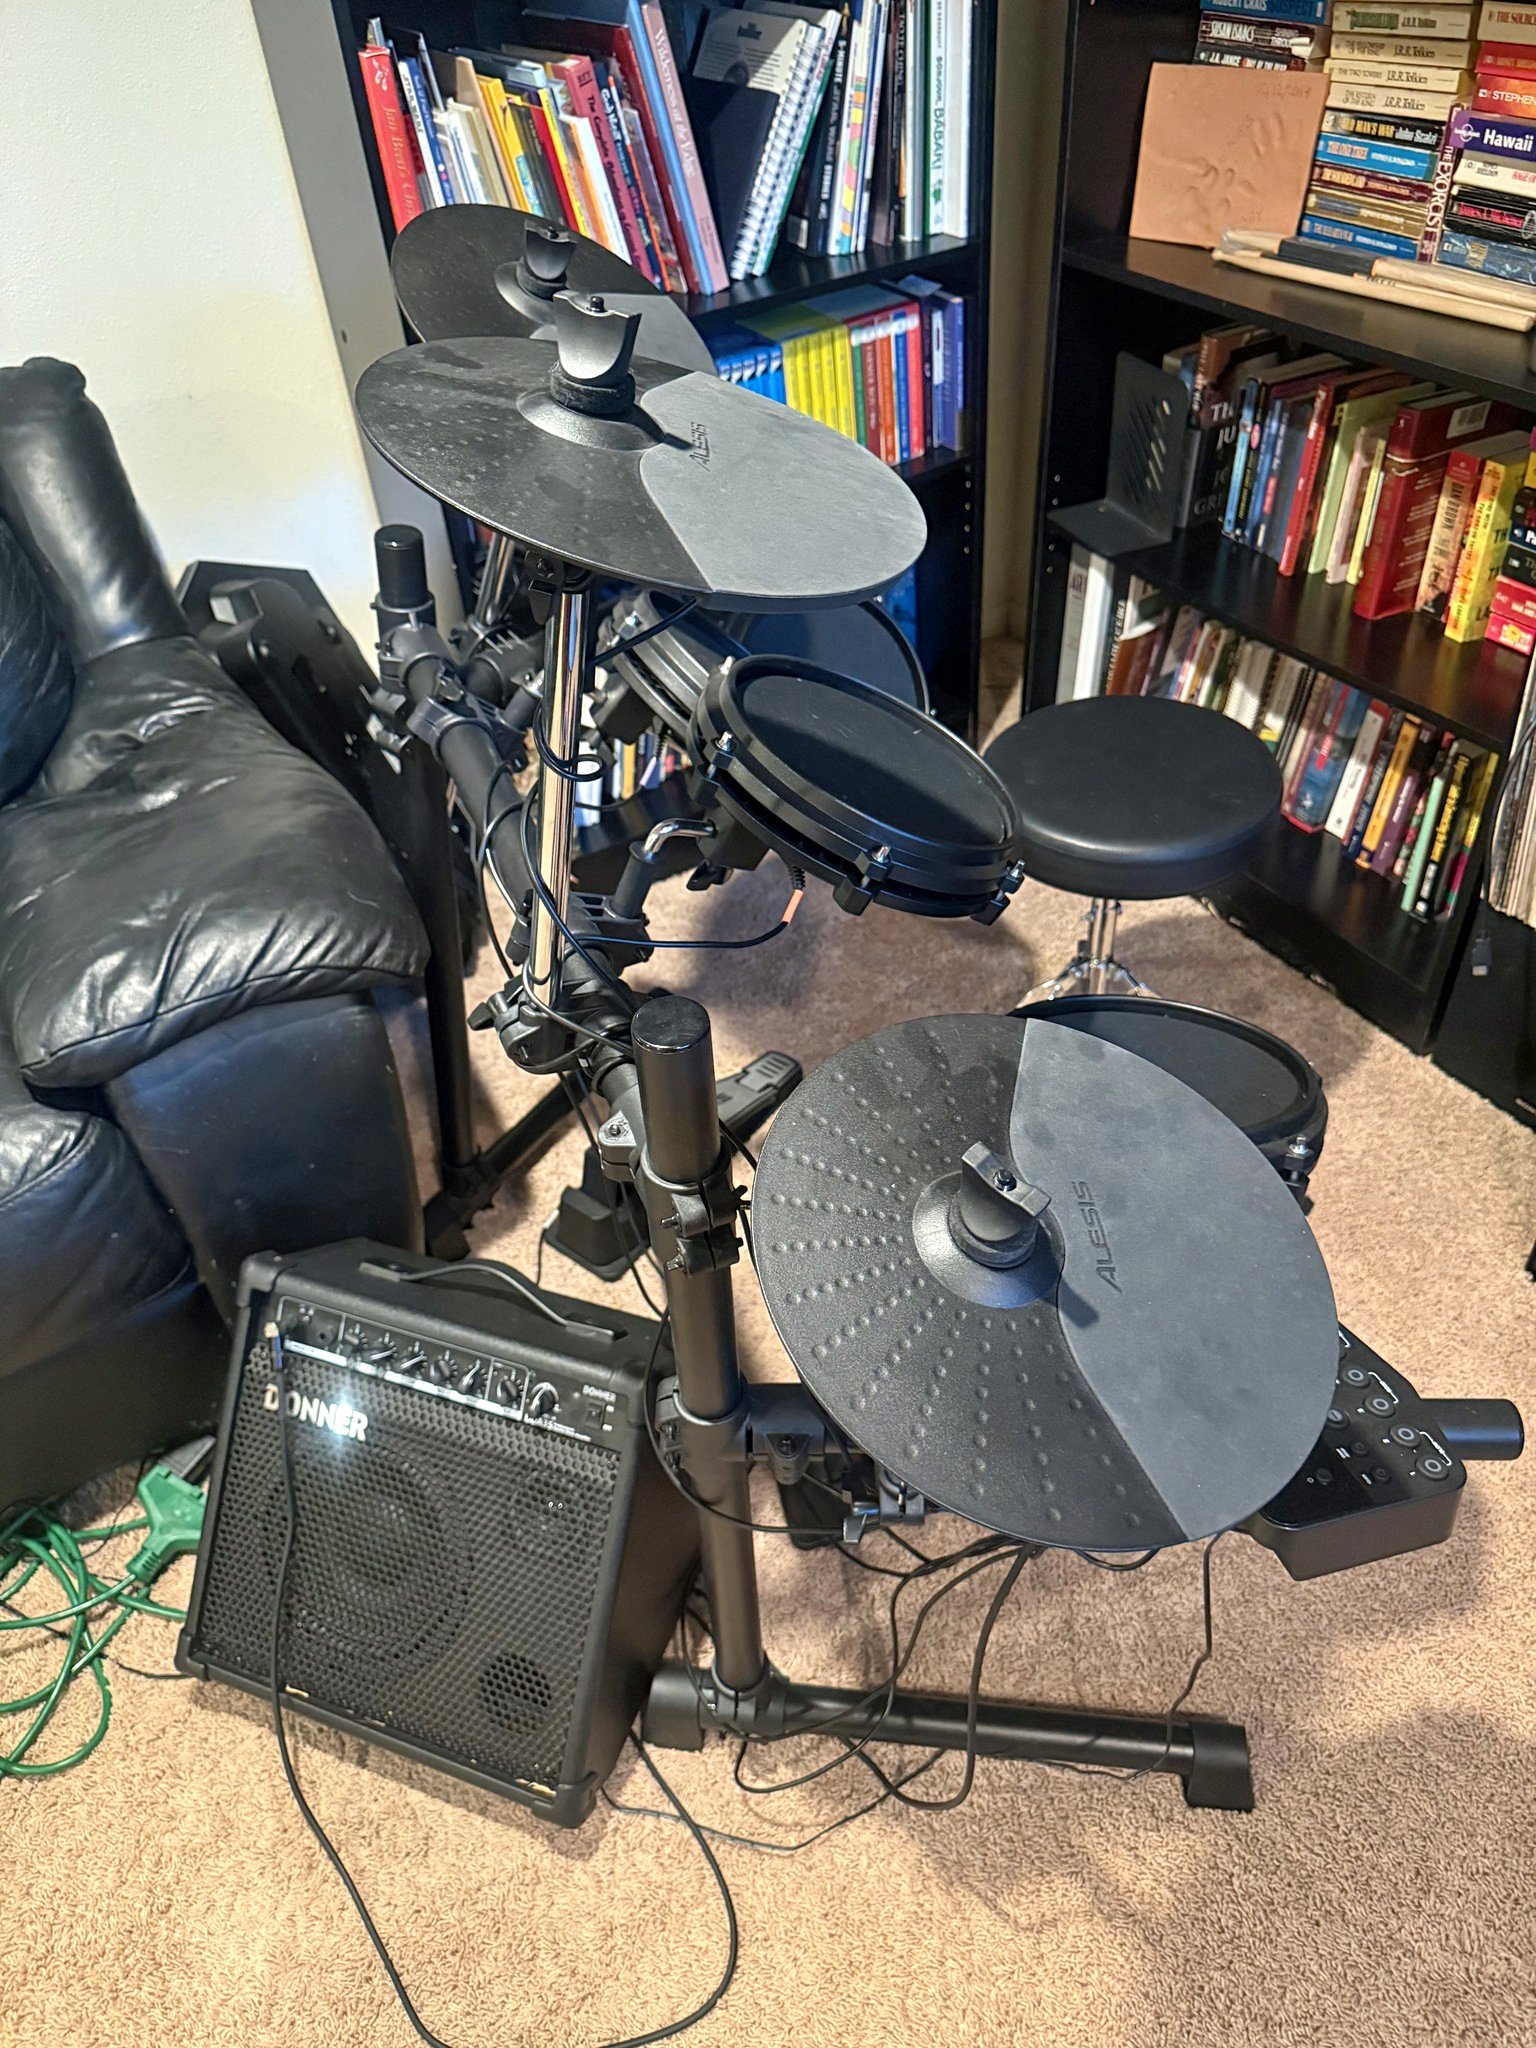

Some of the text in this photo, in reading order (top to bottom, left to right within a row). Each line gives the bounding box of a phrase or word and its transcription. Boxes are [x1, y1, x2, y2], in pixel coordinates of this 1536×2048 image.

[1211, 20, 1256, 42] SUSAN ISAACS
[587, 96, 595, 114] The
[593, 115, 611, 160] Complete
[1483, 128, 1535, 152] Hawaii
[1425, 145, 1454, 233] THE EXORCIST
[689, 421, 711, 473] ALESIS
[1442, 500, 1460, 530] BROWN
[1450, 482, 1464, 500] DAN
[1071, 1181, 1123, 1294] ALESIS
[263, 1382, 369, 1441] DONNER
